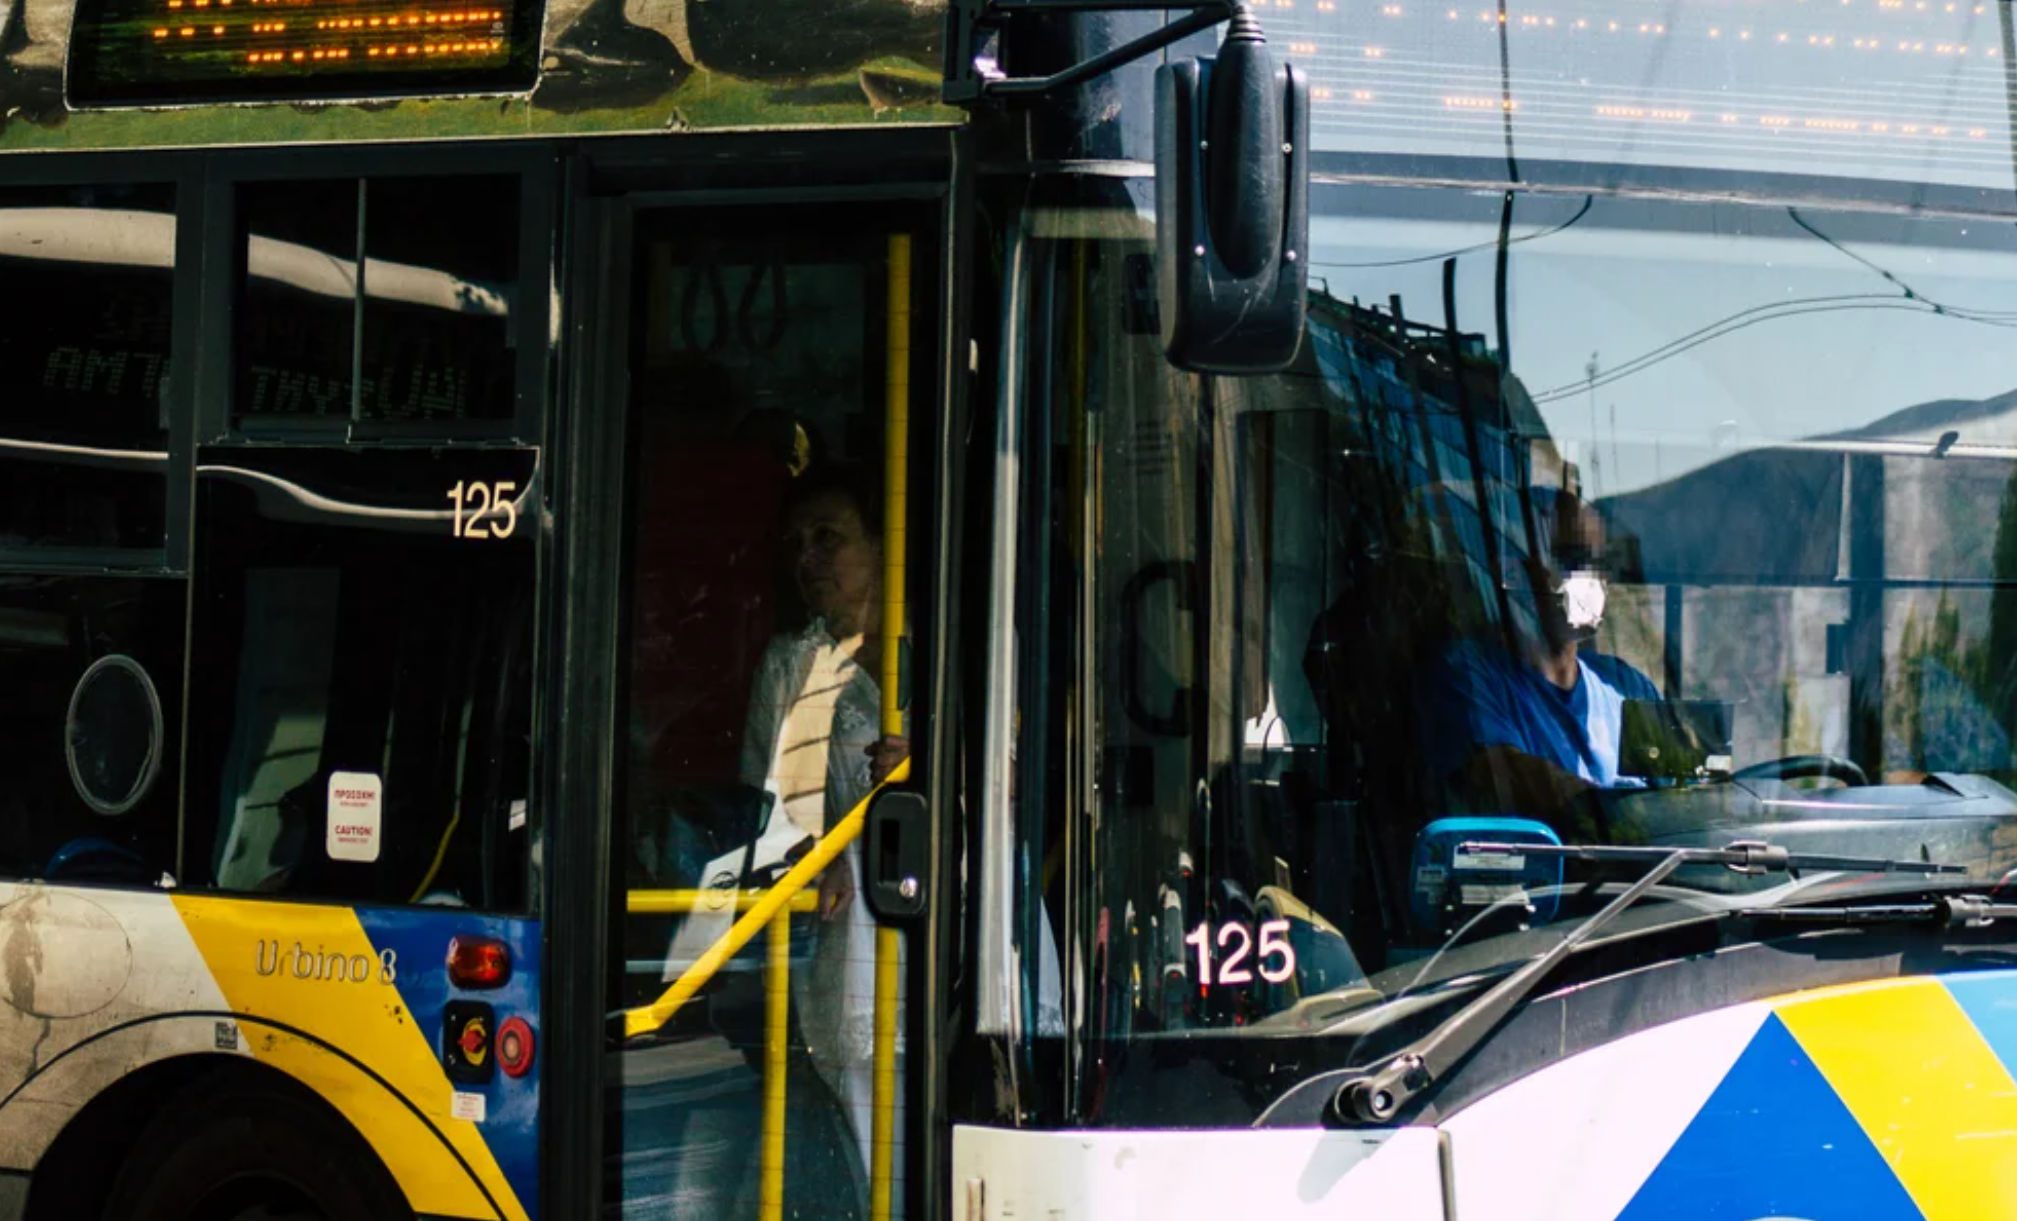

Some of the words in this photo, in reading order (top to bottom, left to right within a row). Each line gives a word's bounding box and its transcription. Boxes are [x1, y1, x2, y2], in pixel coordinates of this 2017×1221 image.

[447, 480, 516, 538] 125
[256, 939, 369, 982] Urbino
[379, 948, 397, 984] 8
[1185, 920, 1295, 984] 125
